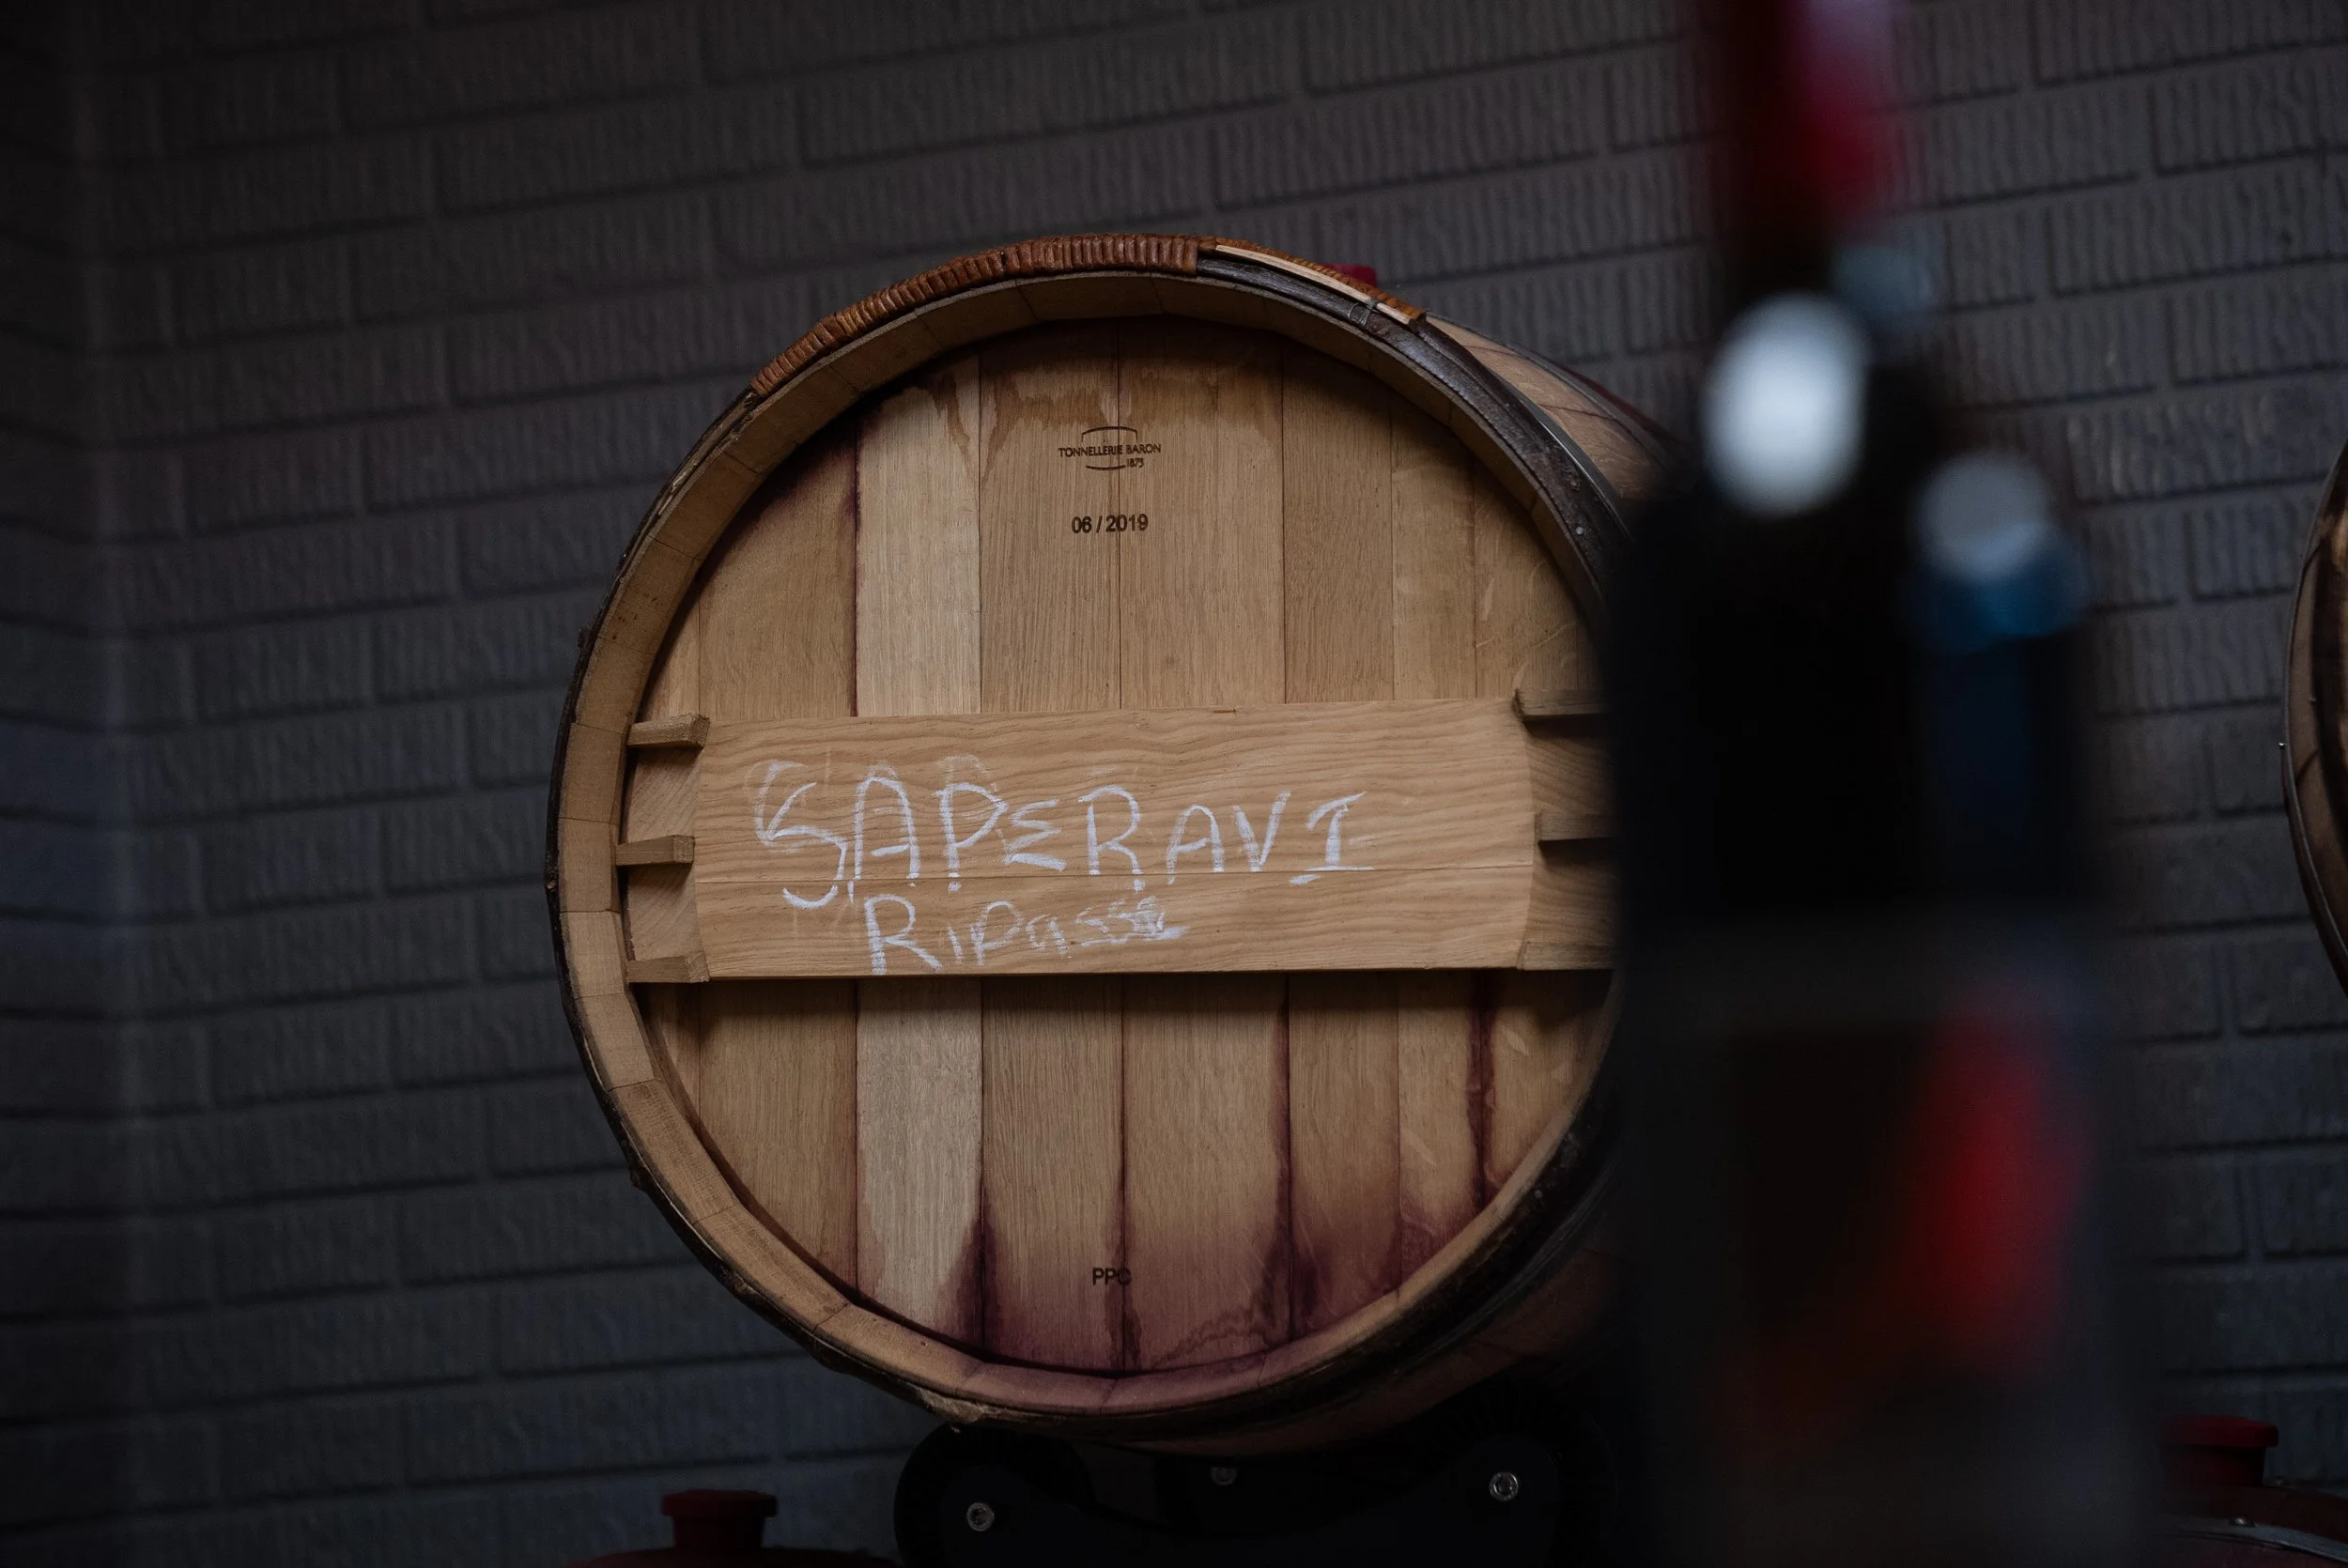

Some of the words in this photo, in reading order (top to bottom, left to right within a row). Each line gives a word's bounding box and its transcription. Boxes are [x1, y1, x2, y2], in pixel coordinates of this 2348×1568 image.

[1058, 445, 1123, 457] TONNELLERIE
[1126, 443, 1162, 454] BARON
[753, 759, 1374, 909] SAPERAVI
